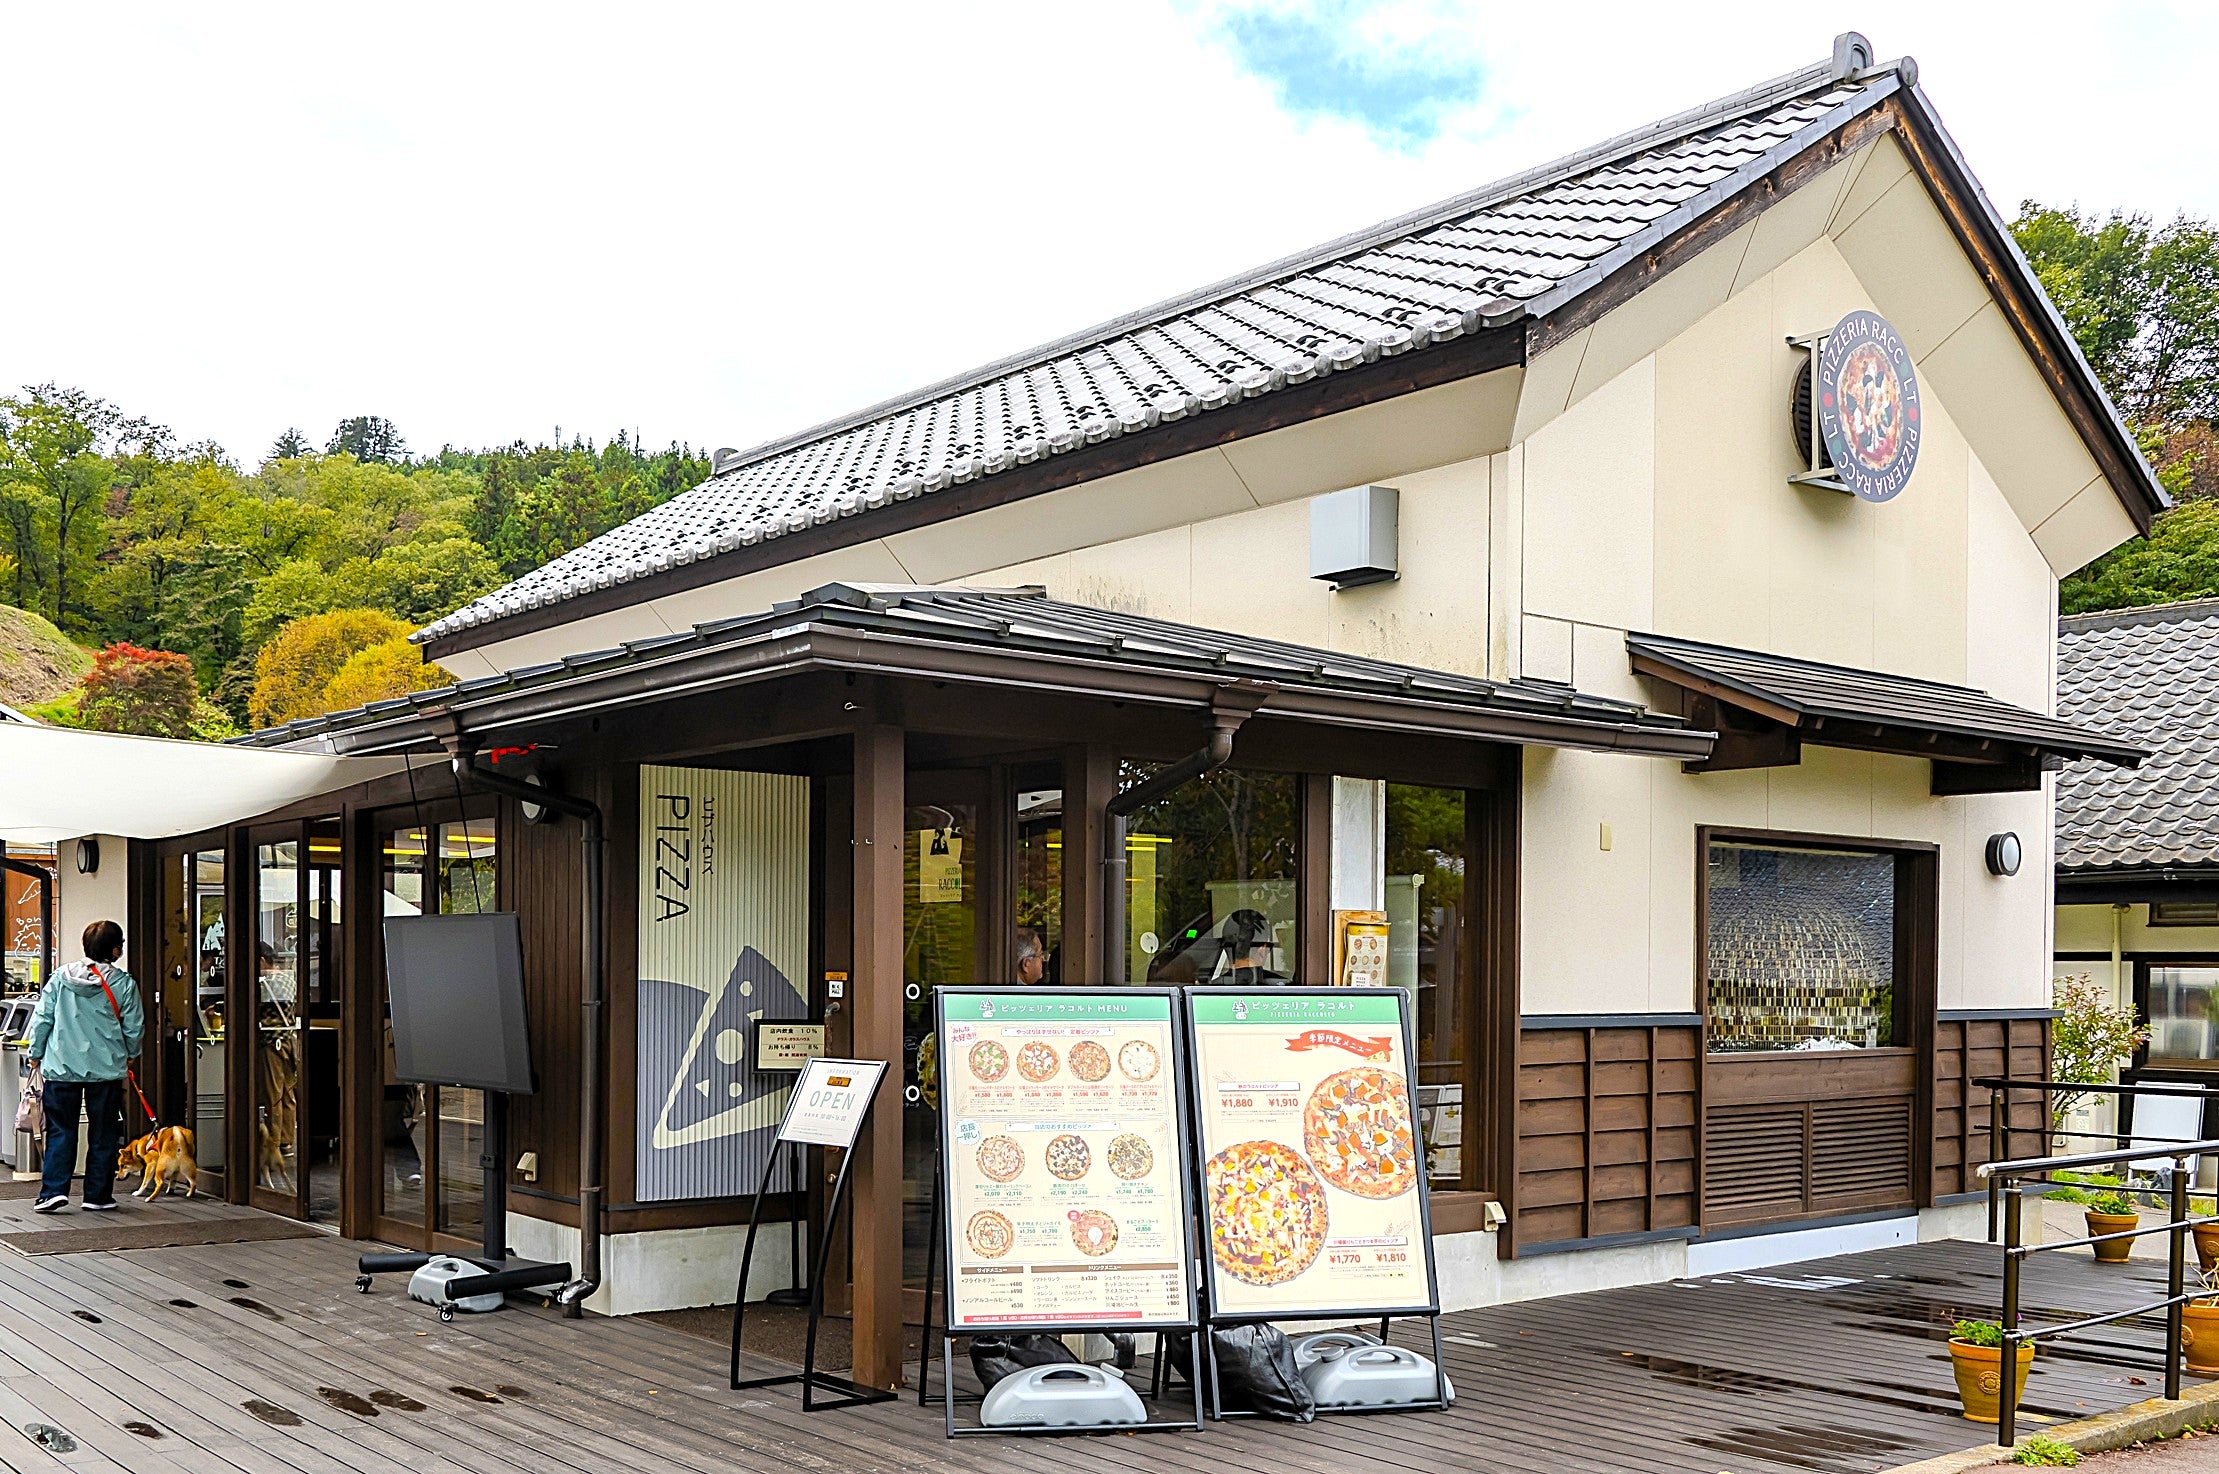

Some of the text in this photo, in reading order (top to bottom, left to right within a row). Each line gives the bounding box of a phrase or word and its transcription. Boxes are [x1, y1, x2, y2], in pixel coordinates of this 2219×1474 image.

[1823, 318, 1868, 386] PIZZERIA
[1876, 428, 1918, 496] PIZZERIA
[701, 796, 715, 875] ピザハウス
[656, 794, 690, 922] PIZZA
[1001, 1004, 1128, 1013] ピッツェリア ラコルト MENU
[1252, 1001, 1355, 1011] ピッツェリア ラコルト
[952, 1026, 970, 1034] みんな
[1309, 1032, 1373, 1053] 季節限定メニュー
[809, 1090, 856, 1111] OPEN
[1221, 1098, 1299, 1108] ¥1,880 ¥1,910
[960, 1122, 976, 1132] 店長
[1329, 1253, 1407, 1264] ¥1,770 ¥1,810
